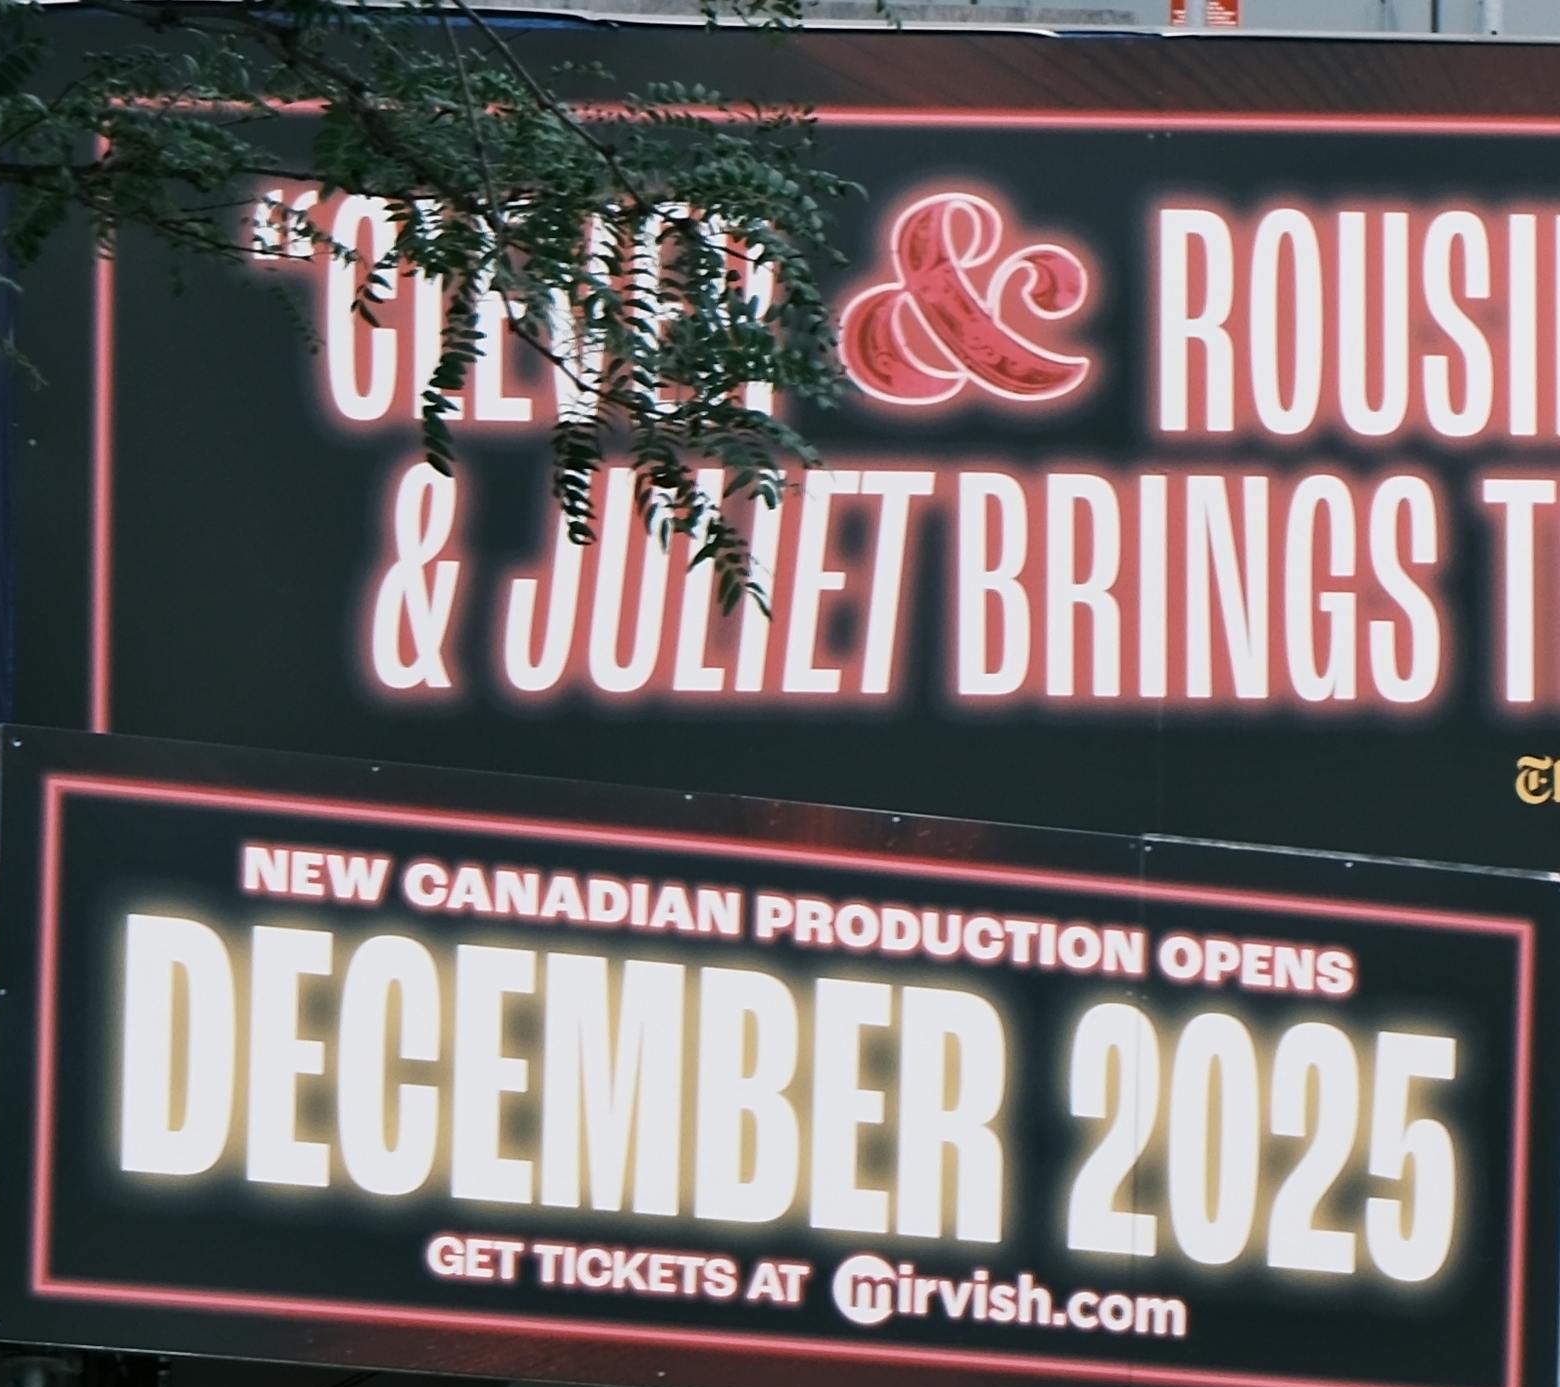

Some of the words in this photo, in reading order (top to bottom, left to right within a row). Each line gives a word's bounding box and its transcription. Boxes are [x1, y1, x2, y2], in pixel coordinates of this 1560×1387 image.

[838, 190, 1092, 408] &
[370, 462, 462, 690] &
[504, 466, 937, 695] JULIET
[957, 470, 1441, 702] BRINGS
[243, 845, 390, 902] NEW
[402, 862, 741, 936] CANADIAN
[756, 888, 1145, 977] PRODUCTION
[1158, 934, 1355, 996] OPENS
[119, 911, 1008, 1246] DECEMBER
[1064, 1002, 1459, 1285] 2025
[426, 1235, 524, 1281] GET
[532, 1243, 737, 1299] TICKETS
[745, 1260, 811, 1304] AT
[832, 1252, 1187, 1338] mirvish.com
